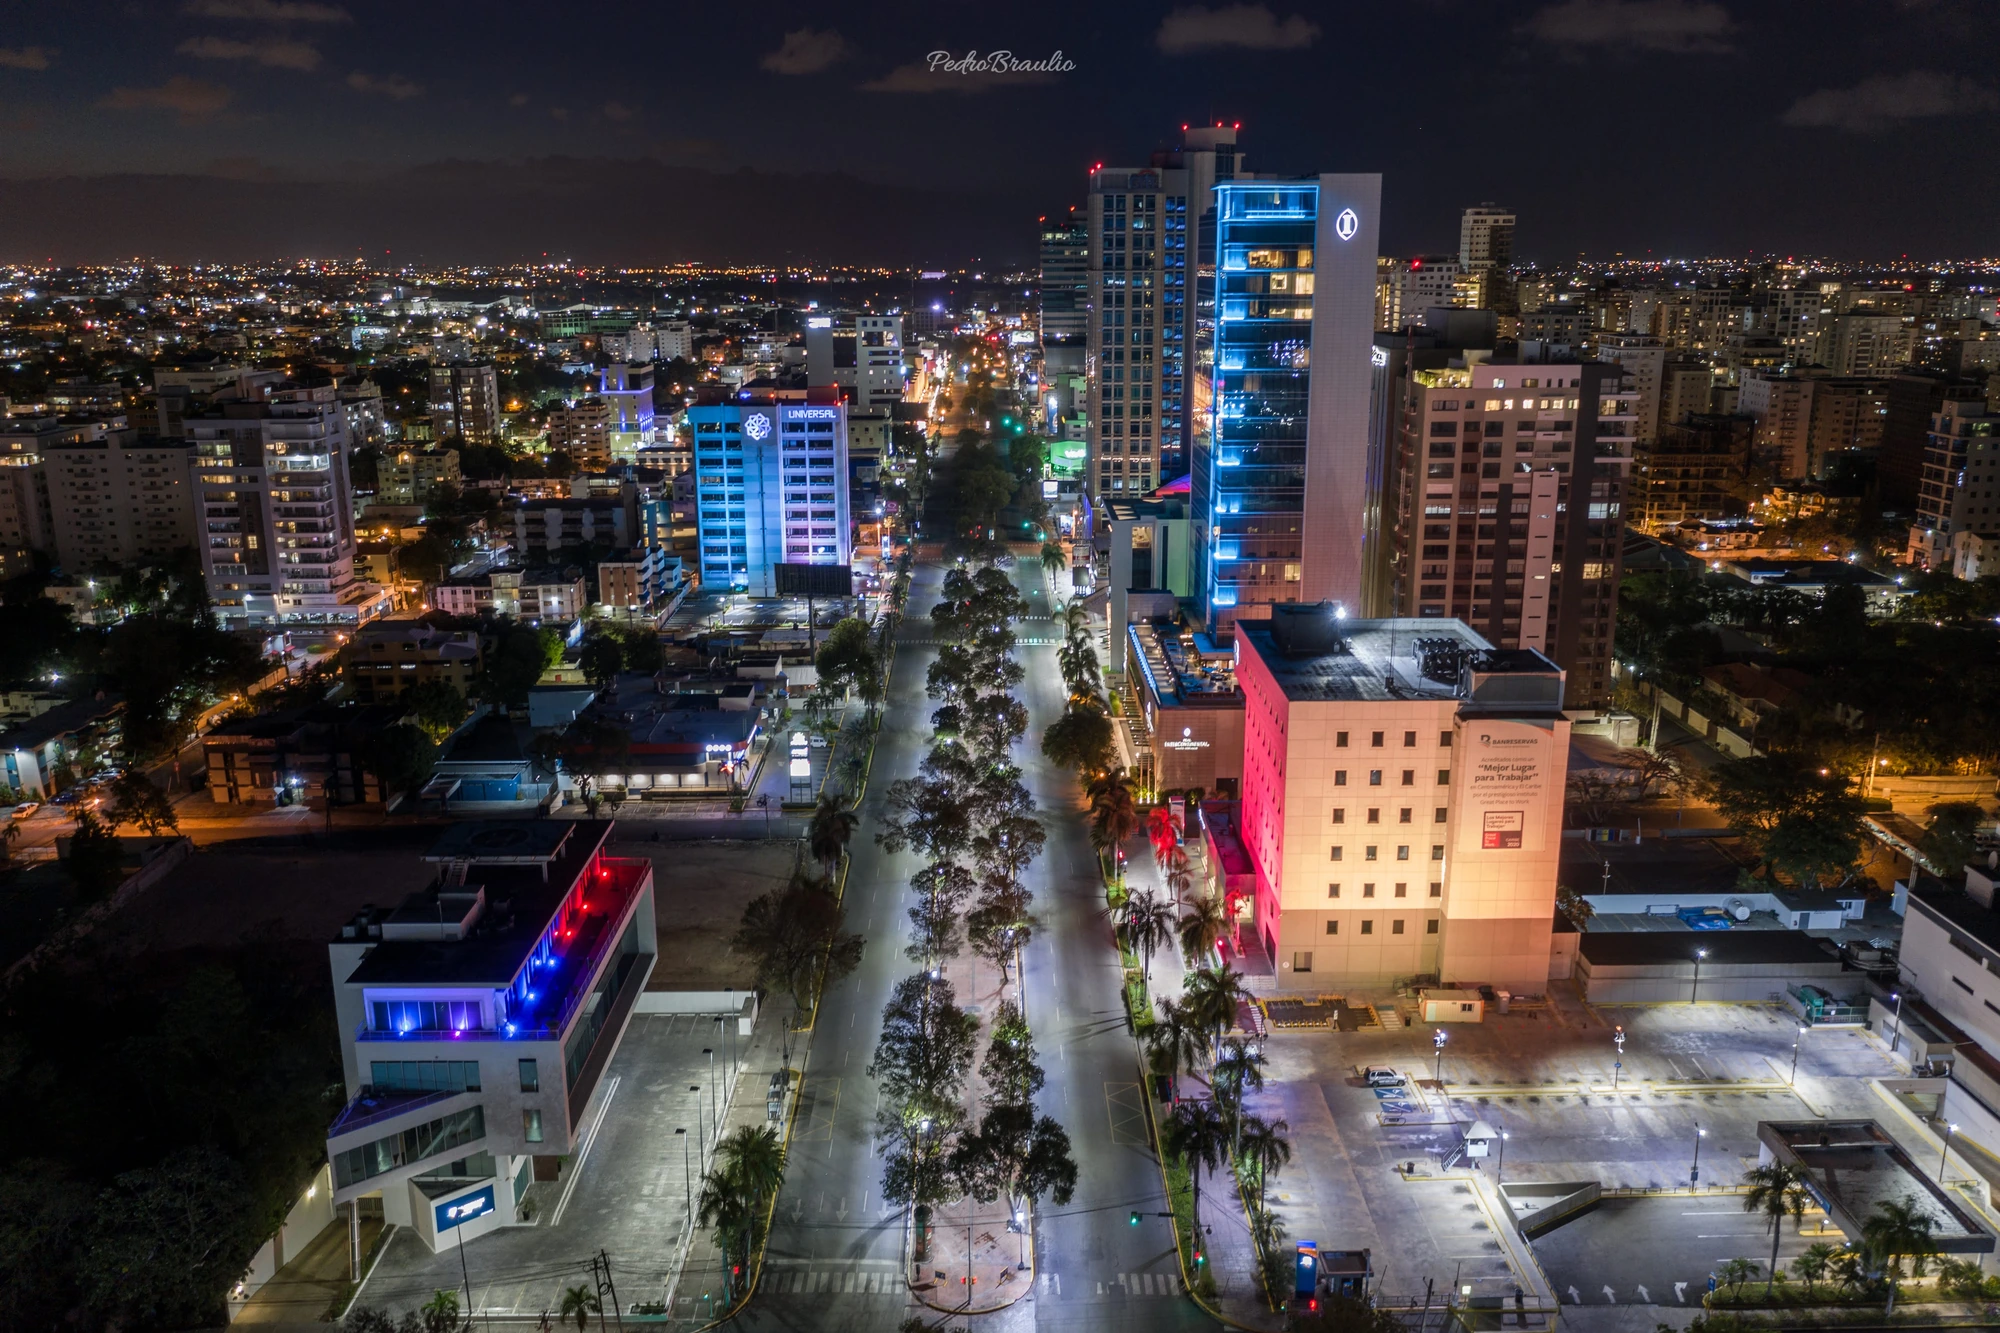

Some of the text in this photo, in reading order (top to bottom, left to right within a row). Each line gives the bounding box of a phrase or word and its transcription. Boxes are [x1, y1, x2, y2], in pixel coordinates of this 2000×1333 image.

[788, 409, 837, 419] UNIVERSAL
[1511, 764, 1537, 773] Lugar
[1474, 775, 1495, 783] para
